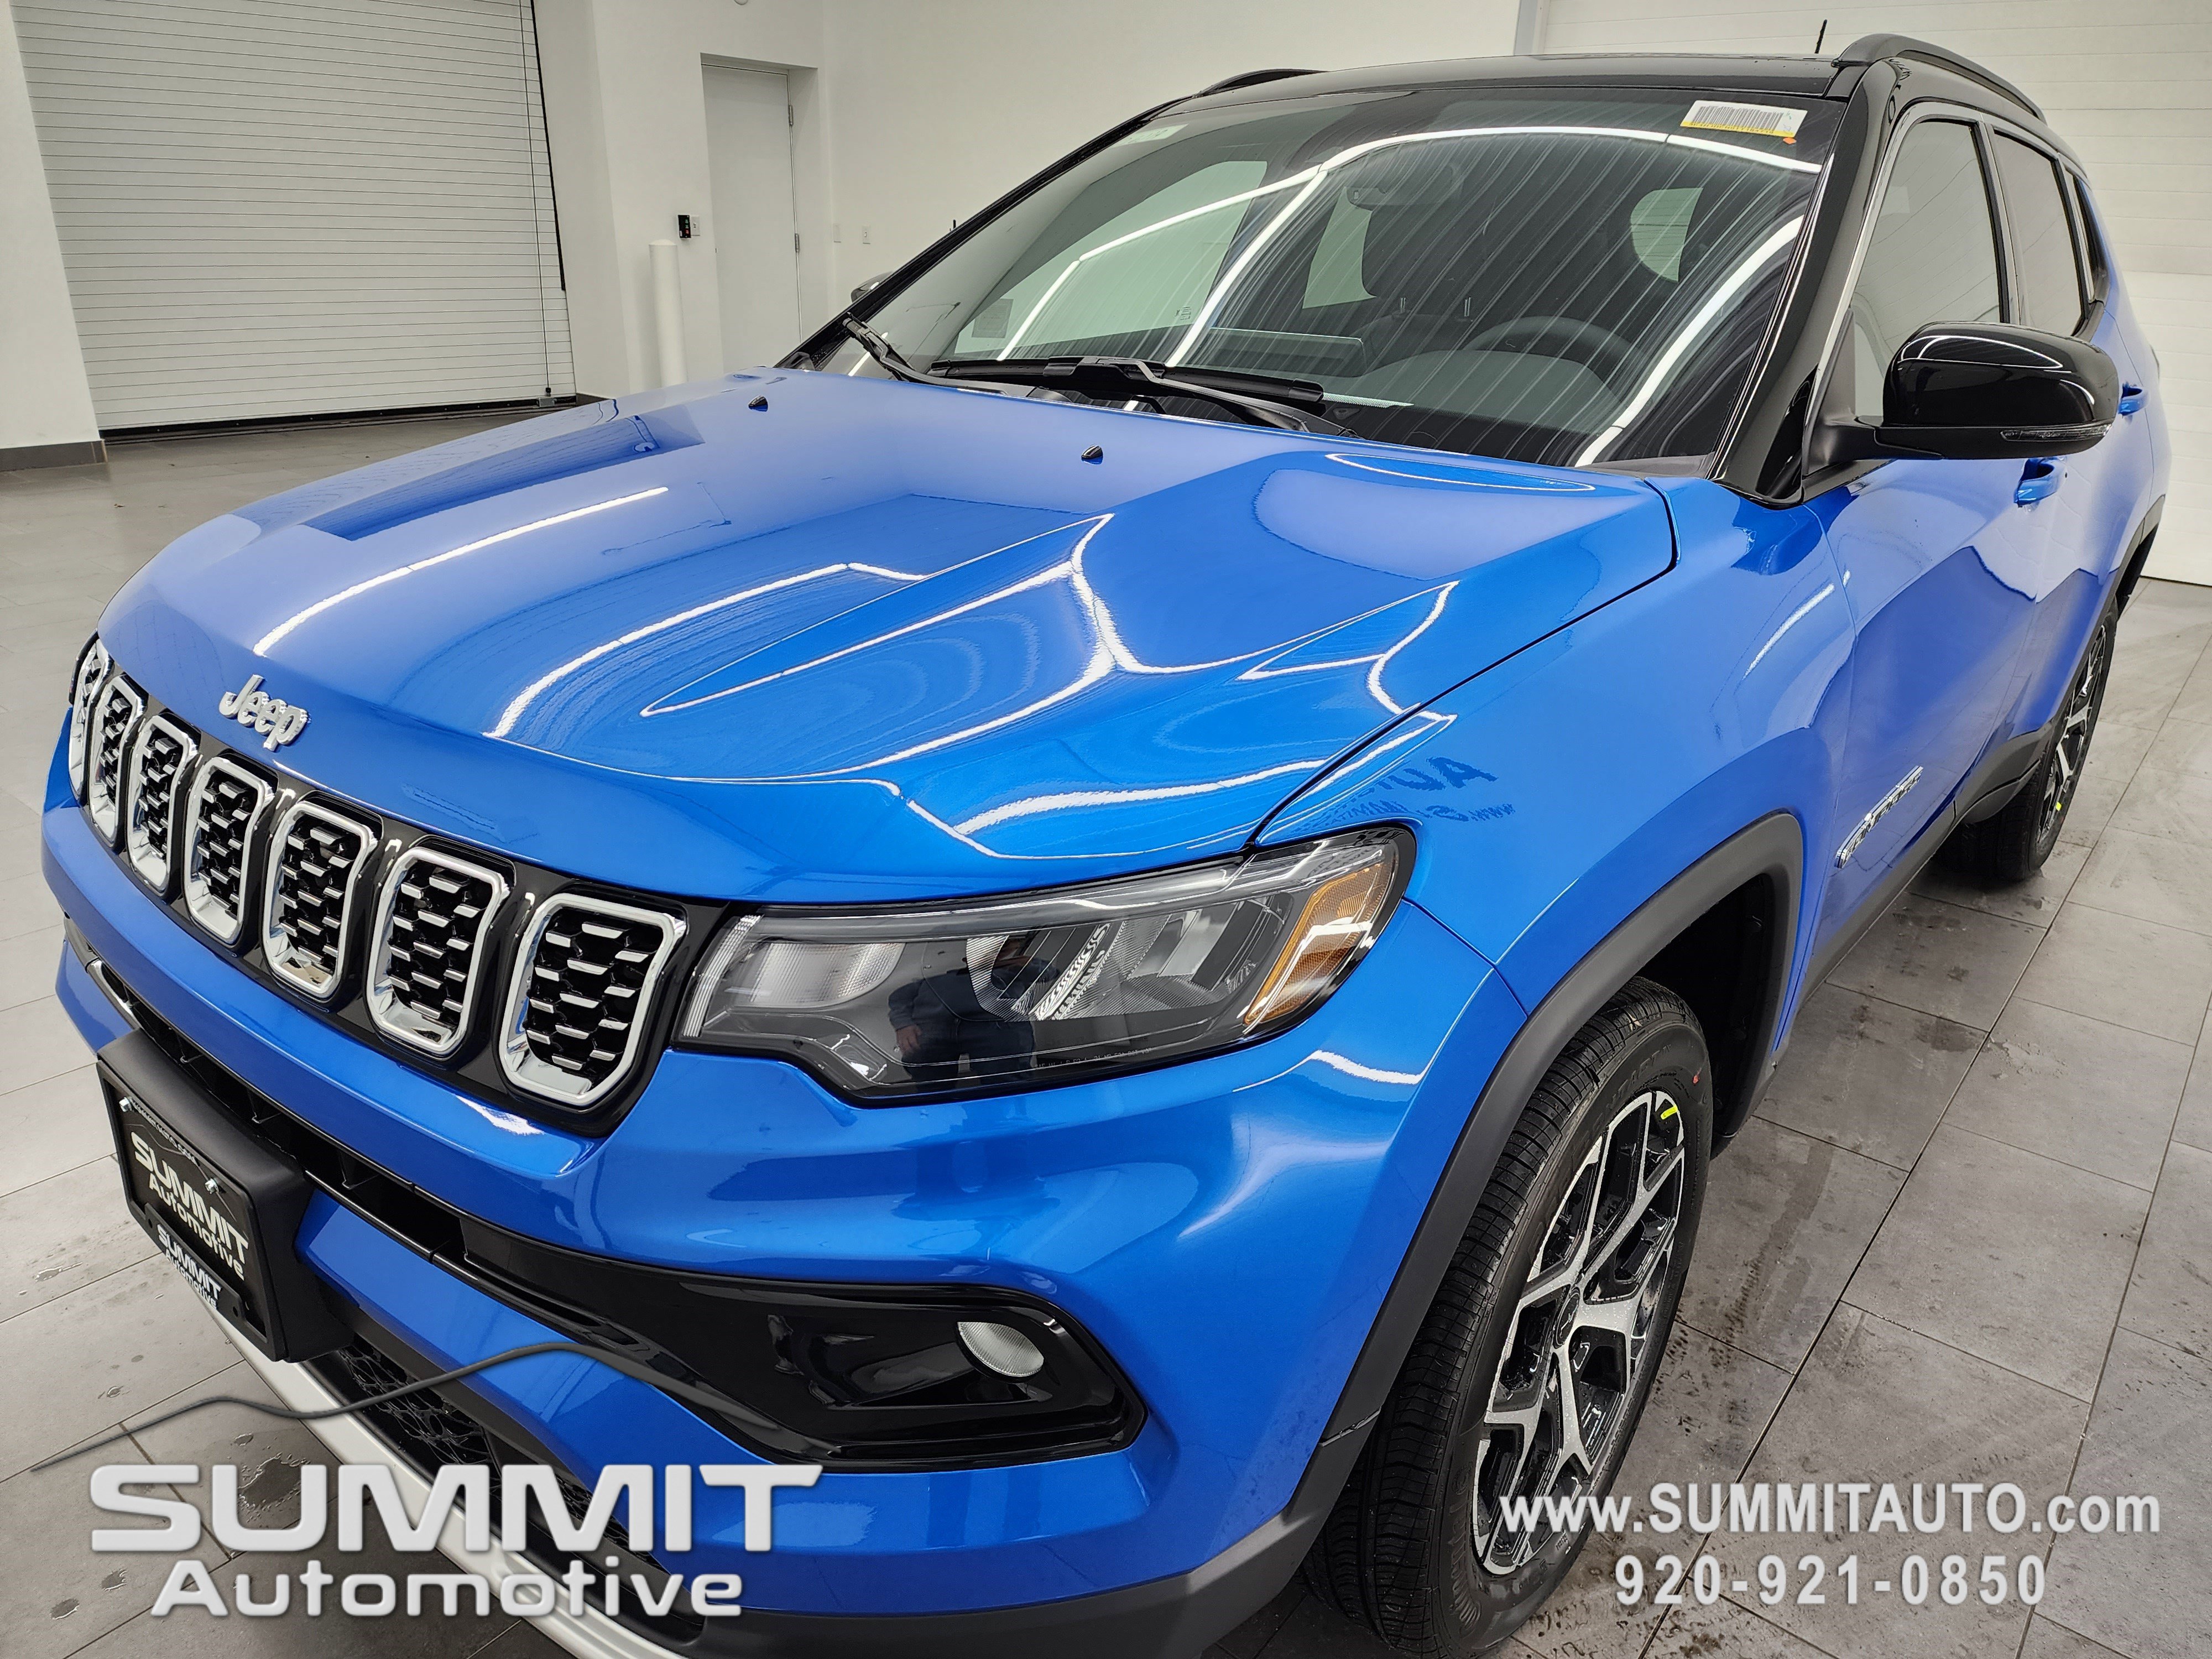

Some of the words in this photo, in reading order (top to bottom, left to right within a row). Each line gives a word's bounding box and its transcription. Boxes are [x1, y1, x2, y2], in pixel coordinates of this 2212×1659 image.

[219, 674, 311, 752] Jeep
[131, 1131, 249, 1265] SUMMIT
[149, 1173, 244, 1281] Automotive
[157, 1224, 222, 1300] SUMMIT
[166, 1249, 218, 1310] Automotive
